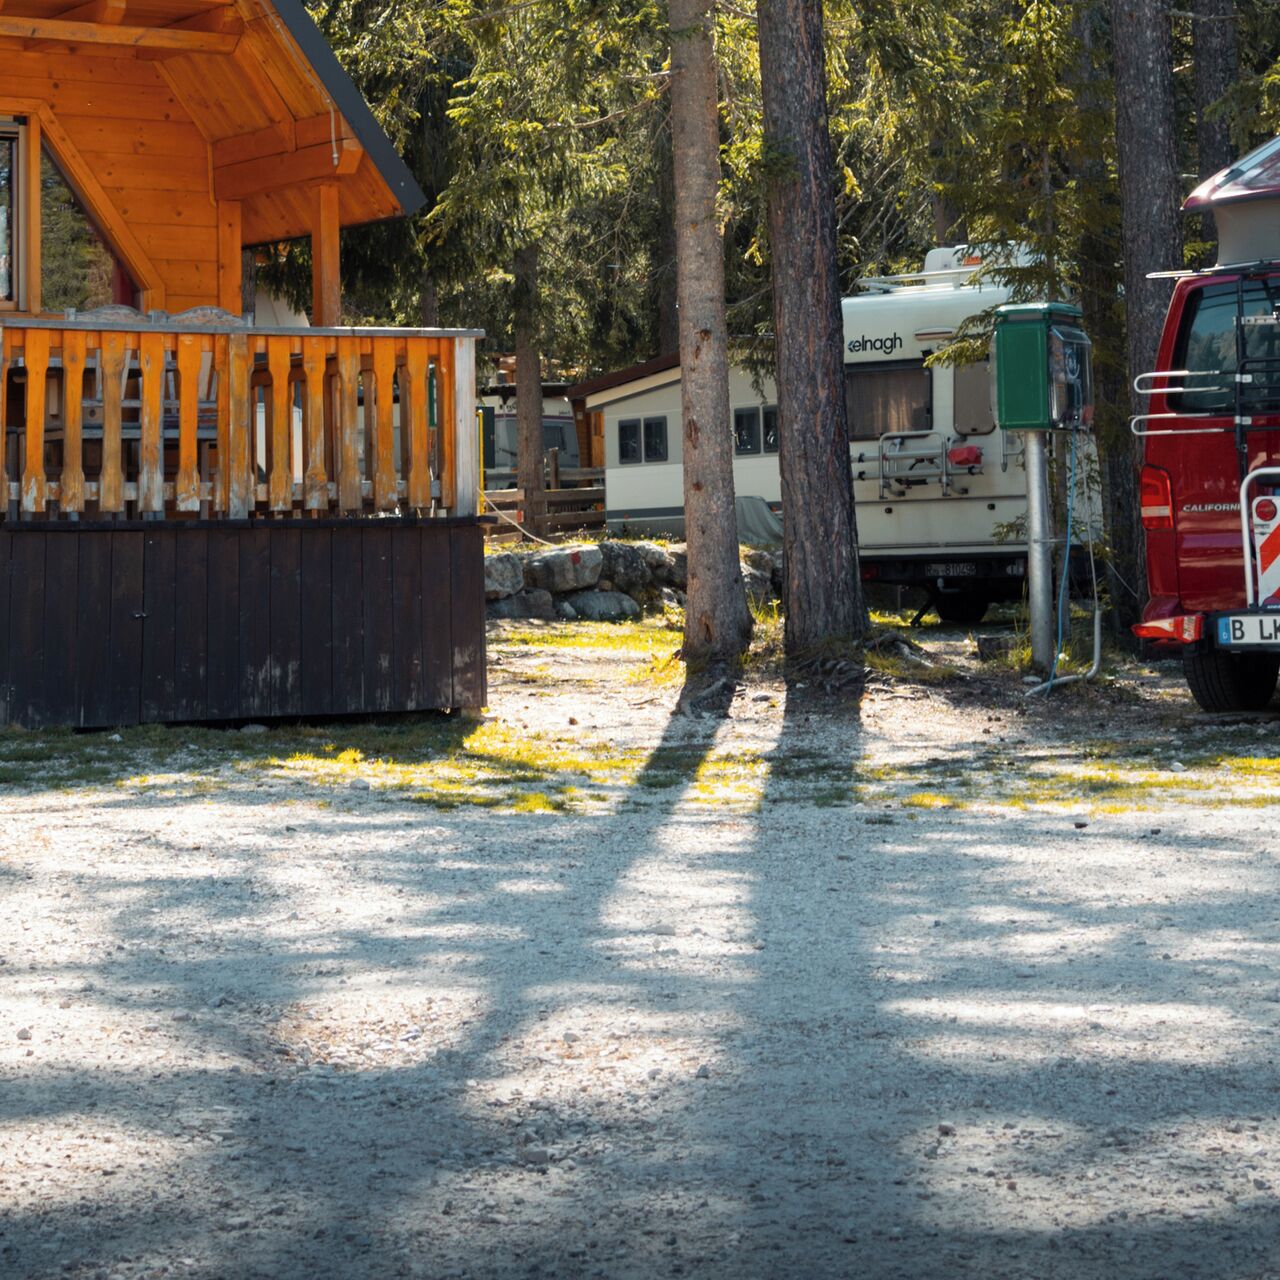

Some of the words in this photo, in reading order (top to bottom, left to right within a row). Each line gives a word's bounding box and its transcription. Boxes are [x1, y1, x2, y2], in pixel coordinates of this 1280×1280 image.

[851, 332, 903, 355] elnagh
[1182, 503, 1240, 512] CALIFORNI
[1231, 619, 1245, 641] B
